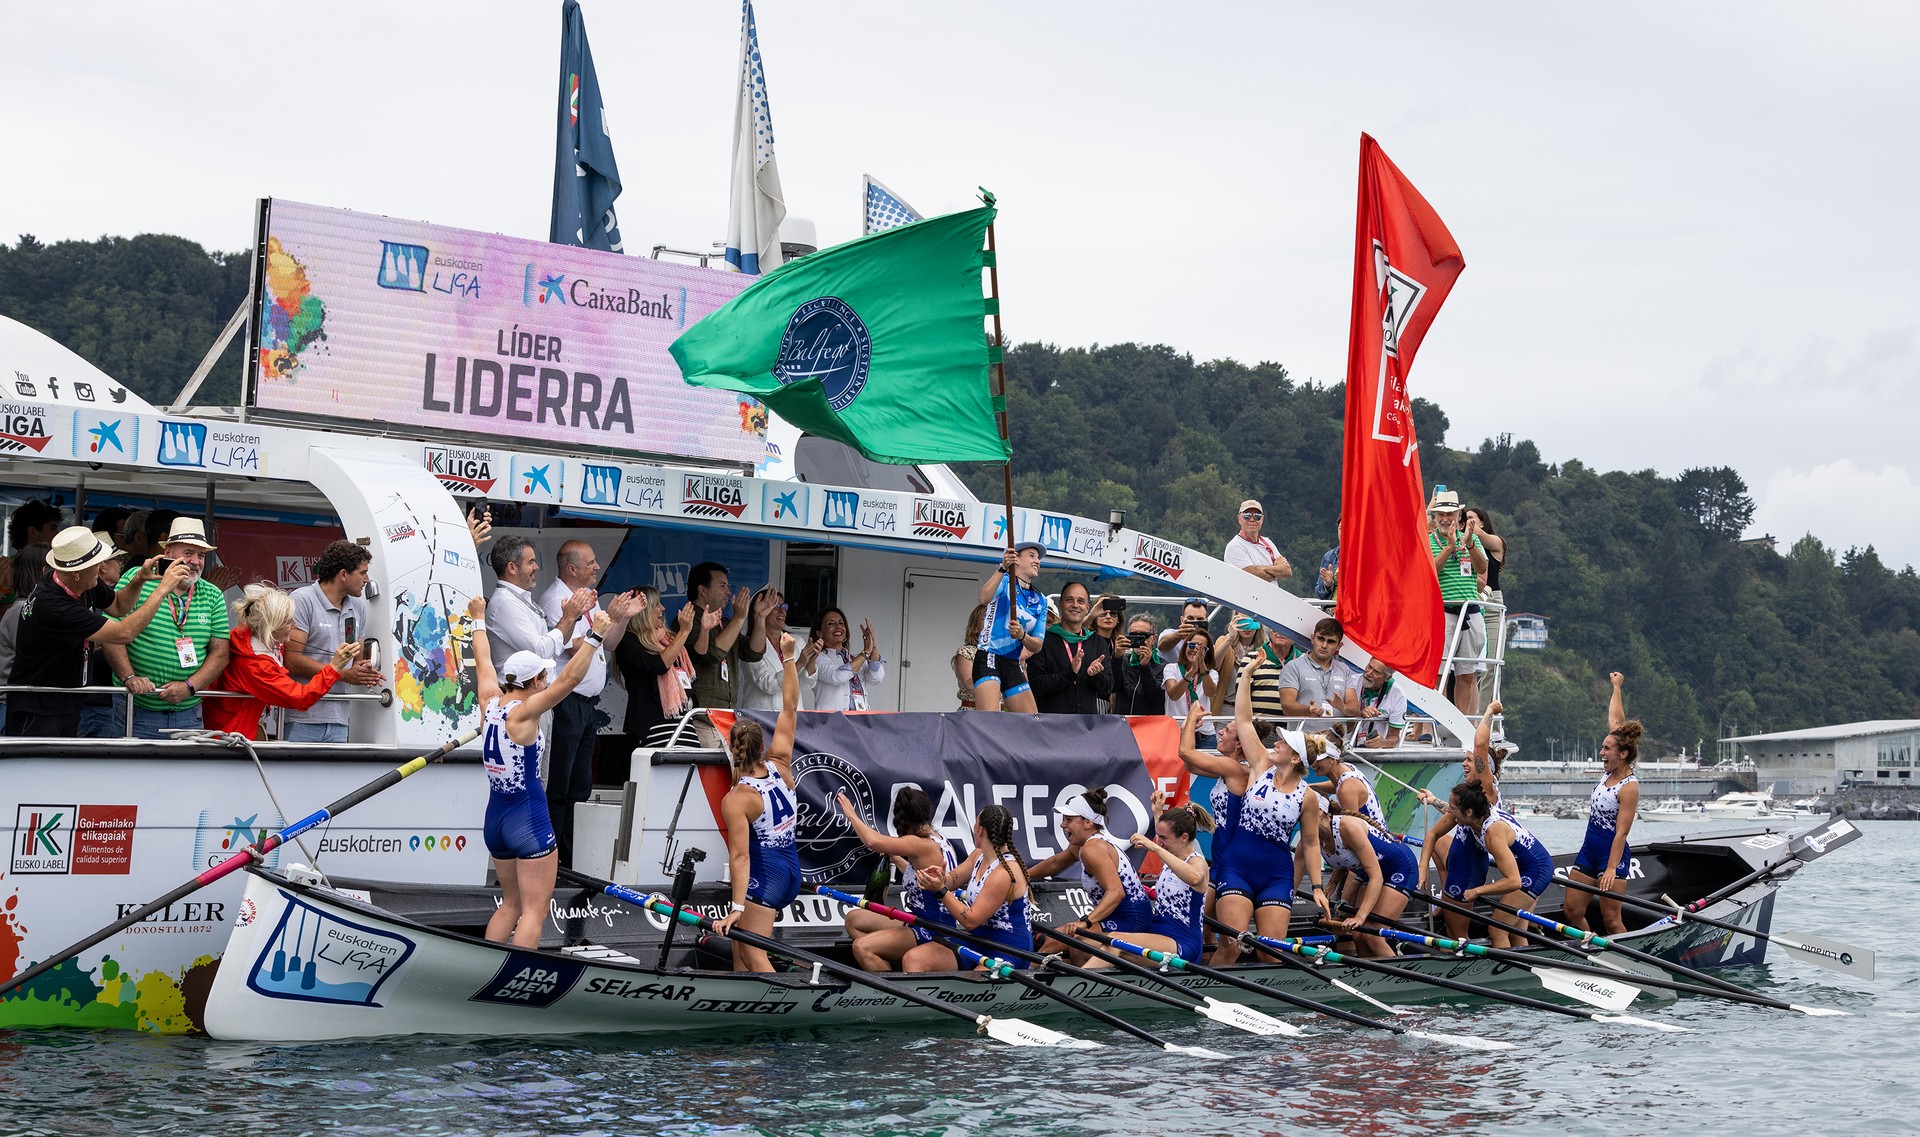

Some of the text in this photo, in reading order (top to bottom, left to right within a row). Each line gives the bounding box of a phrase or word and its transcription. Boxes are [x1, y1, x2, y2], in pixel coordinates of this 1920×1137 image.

[434, 255, 483, 272] euskotren
[433, 271, 481, 299] LIGA
[570, 279, 674, 321] CaixaBank
[497, 323, 562, 362] LÍDER
[422, 352, 634, 434] LIDERRA
[22, 406, 46, 417] LABEL
[0, 415, 45, 437] IGA
[212, 431, 260, 445] euskotren
[211, 446, 259, 470] LIGA
[448, 449, 492, 462] EUSKO LABEL
[448, 461, 491, 480] LIGA
[626, 475, 665, 487] euskotren
[705, 476, 744, 489] EUSKO LABEL
[625, 487, 664, 509] LIGA
[704, 485, 742, 505] LIGA
[862, 499, 898, 510] euskotren
[932, 500, 967, 512] EUSKO LABEL
[861, 511, 896, 532] LIGA
[932, 510, 966, 527] LIGA
[1074, 525, 1106, 538] euskotren
[1072, 537, 1105, 558] LIGA
[1153, 538, 1183, 554] EUSKO LABEL
[1150, 550, 1181, 569] LIGA
[795, 756, 865, 787] EXCELLENCE
[79, 817, 134, 829] Goi-mailako
[81, 831, 127, 842] elikagaiak
[319, 835, 402, 853] euskotren
[81, 845, 124, 854] Alimentos de
[15, 860, 65, 869] EUSKO LABEL
[76, 855, 127, 864] calidad superior
[125, 925, 212, 934] DONOSTIA 1872
[328, 929, 397, 956] euskotren
[318, 943, 389, 974] LIGA
[514, 967, 559, 984] ARA
[494, 989, 531, 1000] DIA
[504, 979, 555, 994] MEN
[937, 989, 997, 1003] Etendo
[691, 1000, 794, 1014] DRUCK
